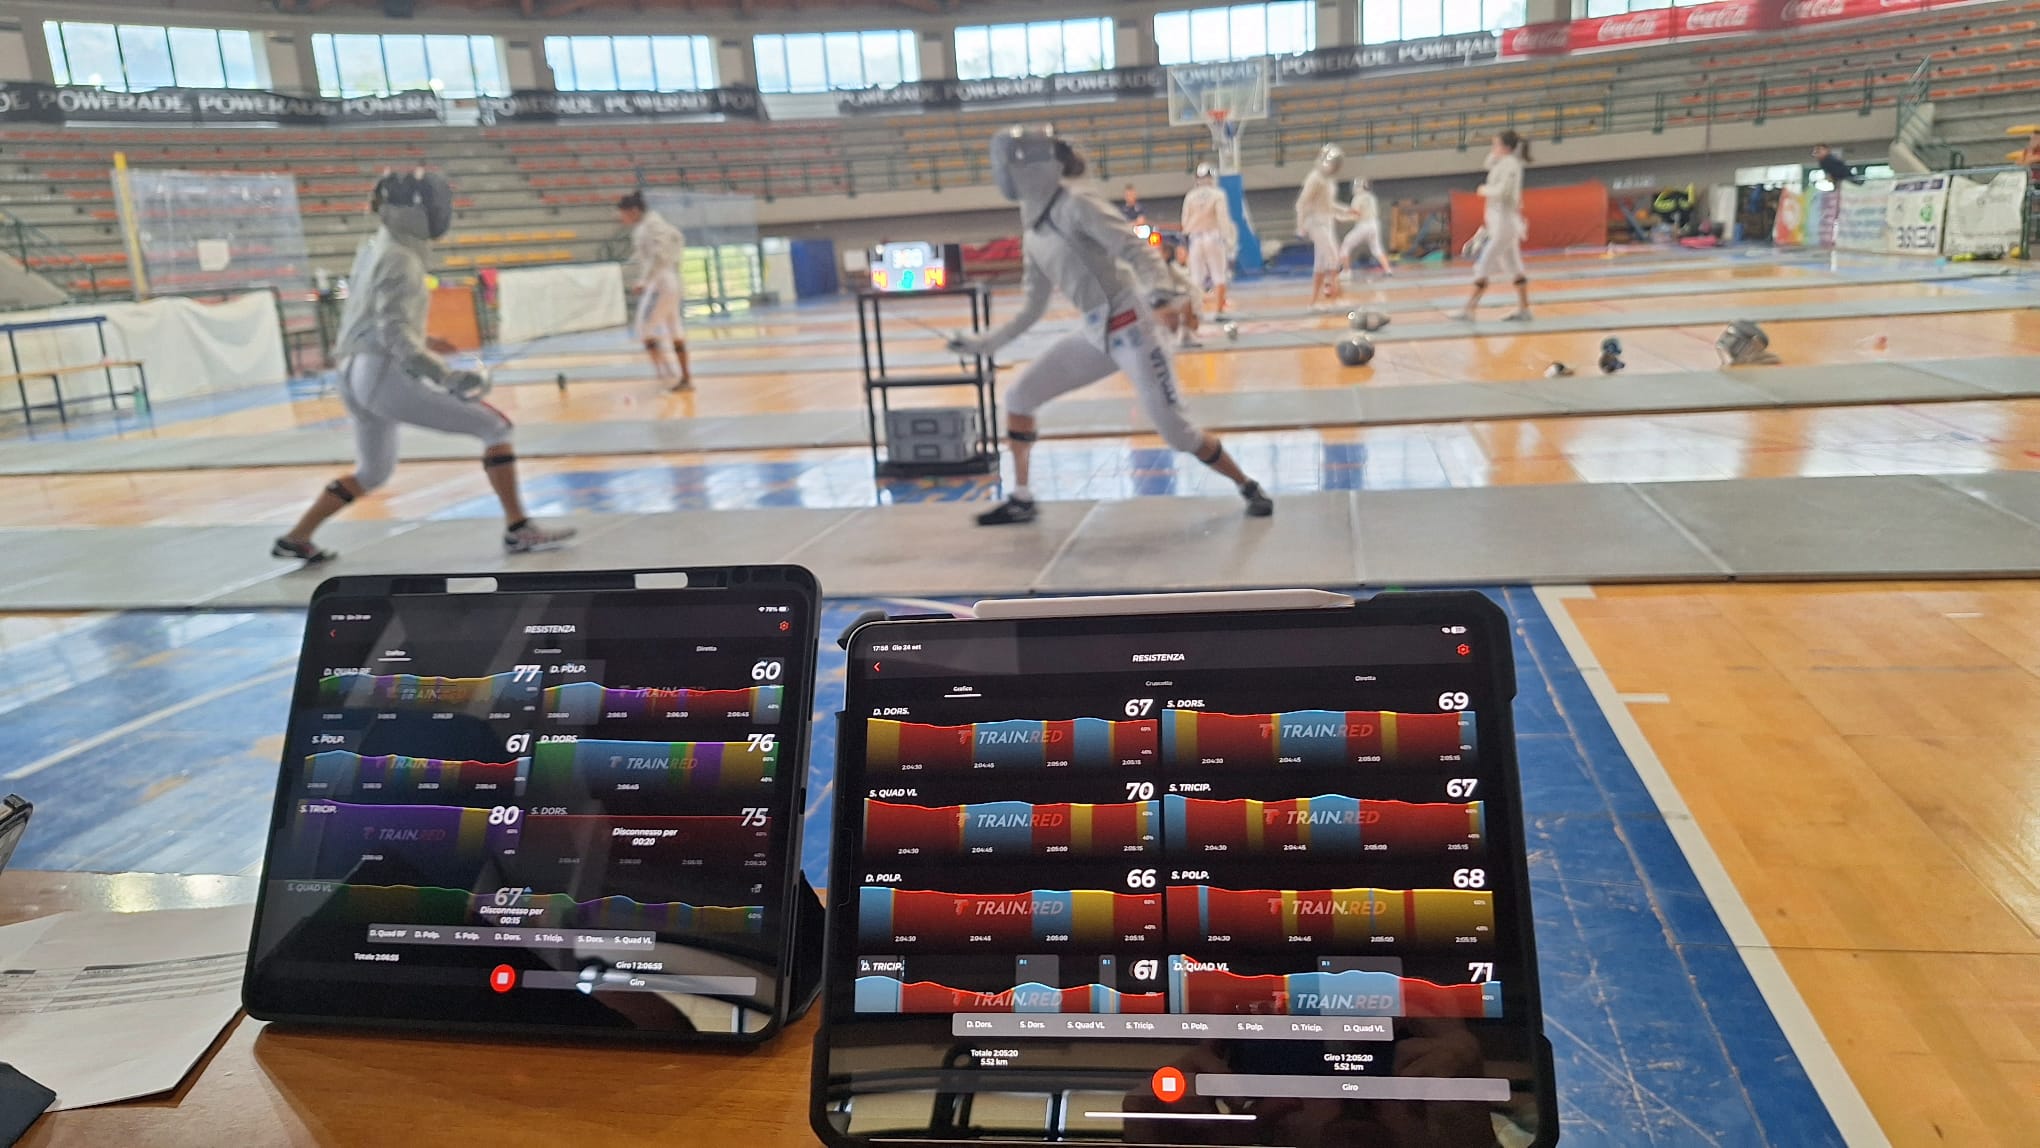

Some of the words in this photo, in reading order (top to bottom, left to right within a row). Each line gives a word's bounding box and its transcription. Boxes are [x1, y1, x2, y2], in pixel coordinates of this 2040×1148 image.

[525, 625, 576, 634] RESISTENZA
[1132, 653, 1185, 662] RESISTENZA
[512, 665, 541, 682] 77
[751, 662, 781, 680] 60
[1177, 700, 1206, 708] DORS.
[1438, 692, 1469, 710] 69
[884, 707, 910, 716] DORS.
[1125, 699, 1153, 717] 67
[1282, 723, 1374, 738] TRAIN.RED
[978, 730, 1064, 745] TRAIN.RED
[506, 734, 530, 753] 61
[747, 734, 775, 752] 76
[627, 757, 698, 769] TRAIN.RED
[1126, 782, 1154, 801] 70
[1169, 784, 1178, 792] S.
[1180, 783, 1211, 792] TRICIP.
[1447, 779, 1478, 798] 67
[879, 788, 904, 798] QUAD
[906, 789, 917, 797] VL
[489, 806, 519, 825] 80
[741, 808, 768, 827] 75
[1287, 810, 1381, 825] TRAIN.RED
[977, 814, 1063, 828] TRAIN.RED
[612, 827, 662, 837] Disconnesso
[662, 829, 678, 838] per
[865, 874, 874, 882] D.
[876, 874, 902, 883] POLP.
[1127, 869, 1156, 888] 66
[1171, 872, 1180, 880] S.
[1182, 871, 1210, 880] POLP.
[1453, 869, 1485, 888] 68
[495, 887, 524, 906] 67
[480, 905, 529, 915] Disconnesso
[529, 908, 544, 917] per
[975, 900, 1064, 916] TRAIN.RED
[1291, 900, 1387, 915] TRAIN.RED
[543, 934, 564, 943] Tricip.
[586, 935, 604, 943] Dors.
[622, 936, 642, 945] Quad
[616, 961, 631, 969] Giro
[861, 963, 870, 971] D.
[872, 962, 903, 971] TRICIP.
[1132, 960, 1158, 980] 61
[1174, 962, 1183, 971] D.
[1186, 962, 1215, 972] QUAD
[1217, 962, 1229, 971] VL
[1468, 962, 1493, 982] 71
[629, 978, 645, 987] Giro
[973, 992, 1063, 1007] TRAIN.RED
[1297, 993, 1394, 1010] TRAIN.RED
[975, 1020, 992, 1029] Dors.
[1028, 1020, 1045, 1029] Dors.
[1067, 1021, 1074, 1029] S.
[1075, 1021, 1095, 1030] Quad
[1096, 1021, 1105, 1029] VL
[1126, 1021, 1132, 1029] S.
[1133, 1021, 1154, 1031] Tricip.
[1182, 1022, 1190, 1030] D.
[1191, 1022, 1208, 1032] Polp.
[1237, 1023, 1245, 1031] S.
[1246, 1022, 1264, 1033] Polp.
[1300, 1023, 1323, 1033] Tricip.
[1344, 1024, 1352, 1032] D.
[1353, 1024, 1374, 1033] Quad
[971, 1049, 992, 1057] Totale
[1324, 1053, 1340, 1062] Giro
[1346, 1054, 1373, 1062] 2:05:20
[980, 1058, 994, 1066] 5.52
[996, 1058, 1008, 1066] km
[1334, 1062, 1349, 1071] 5.52
[1351, 1062, 1364, 1071] km
[1342, 1083, 1359, 1092] Giro
